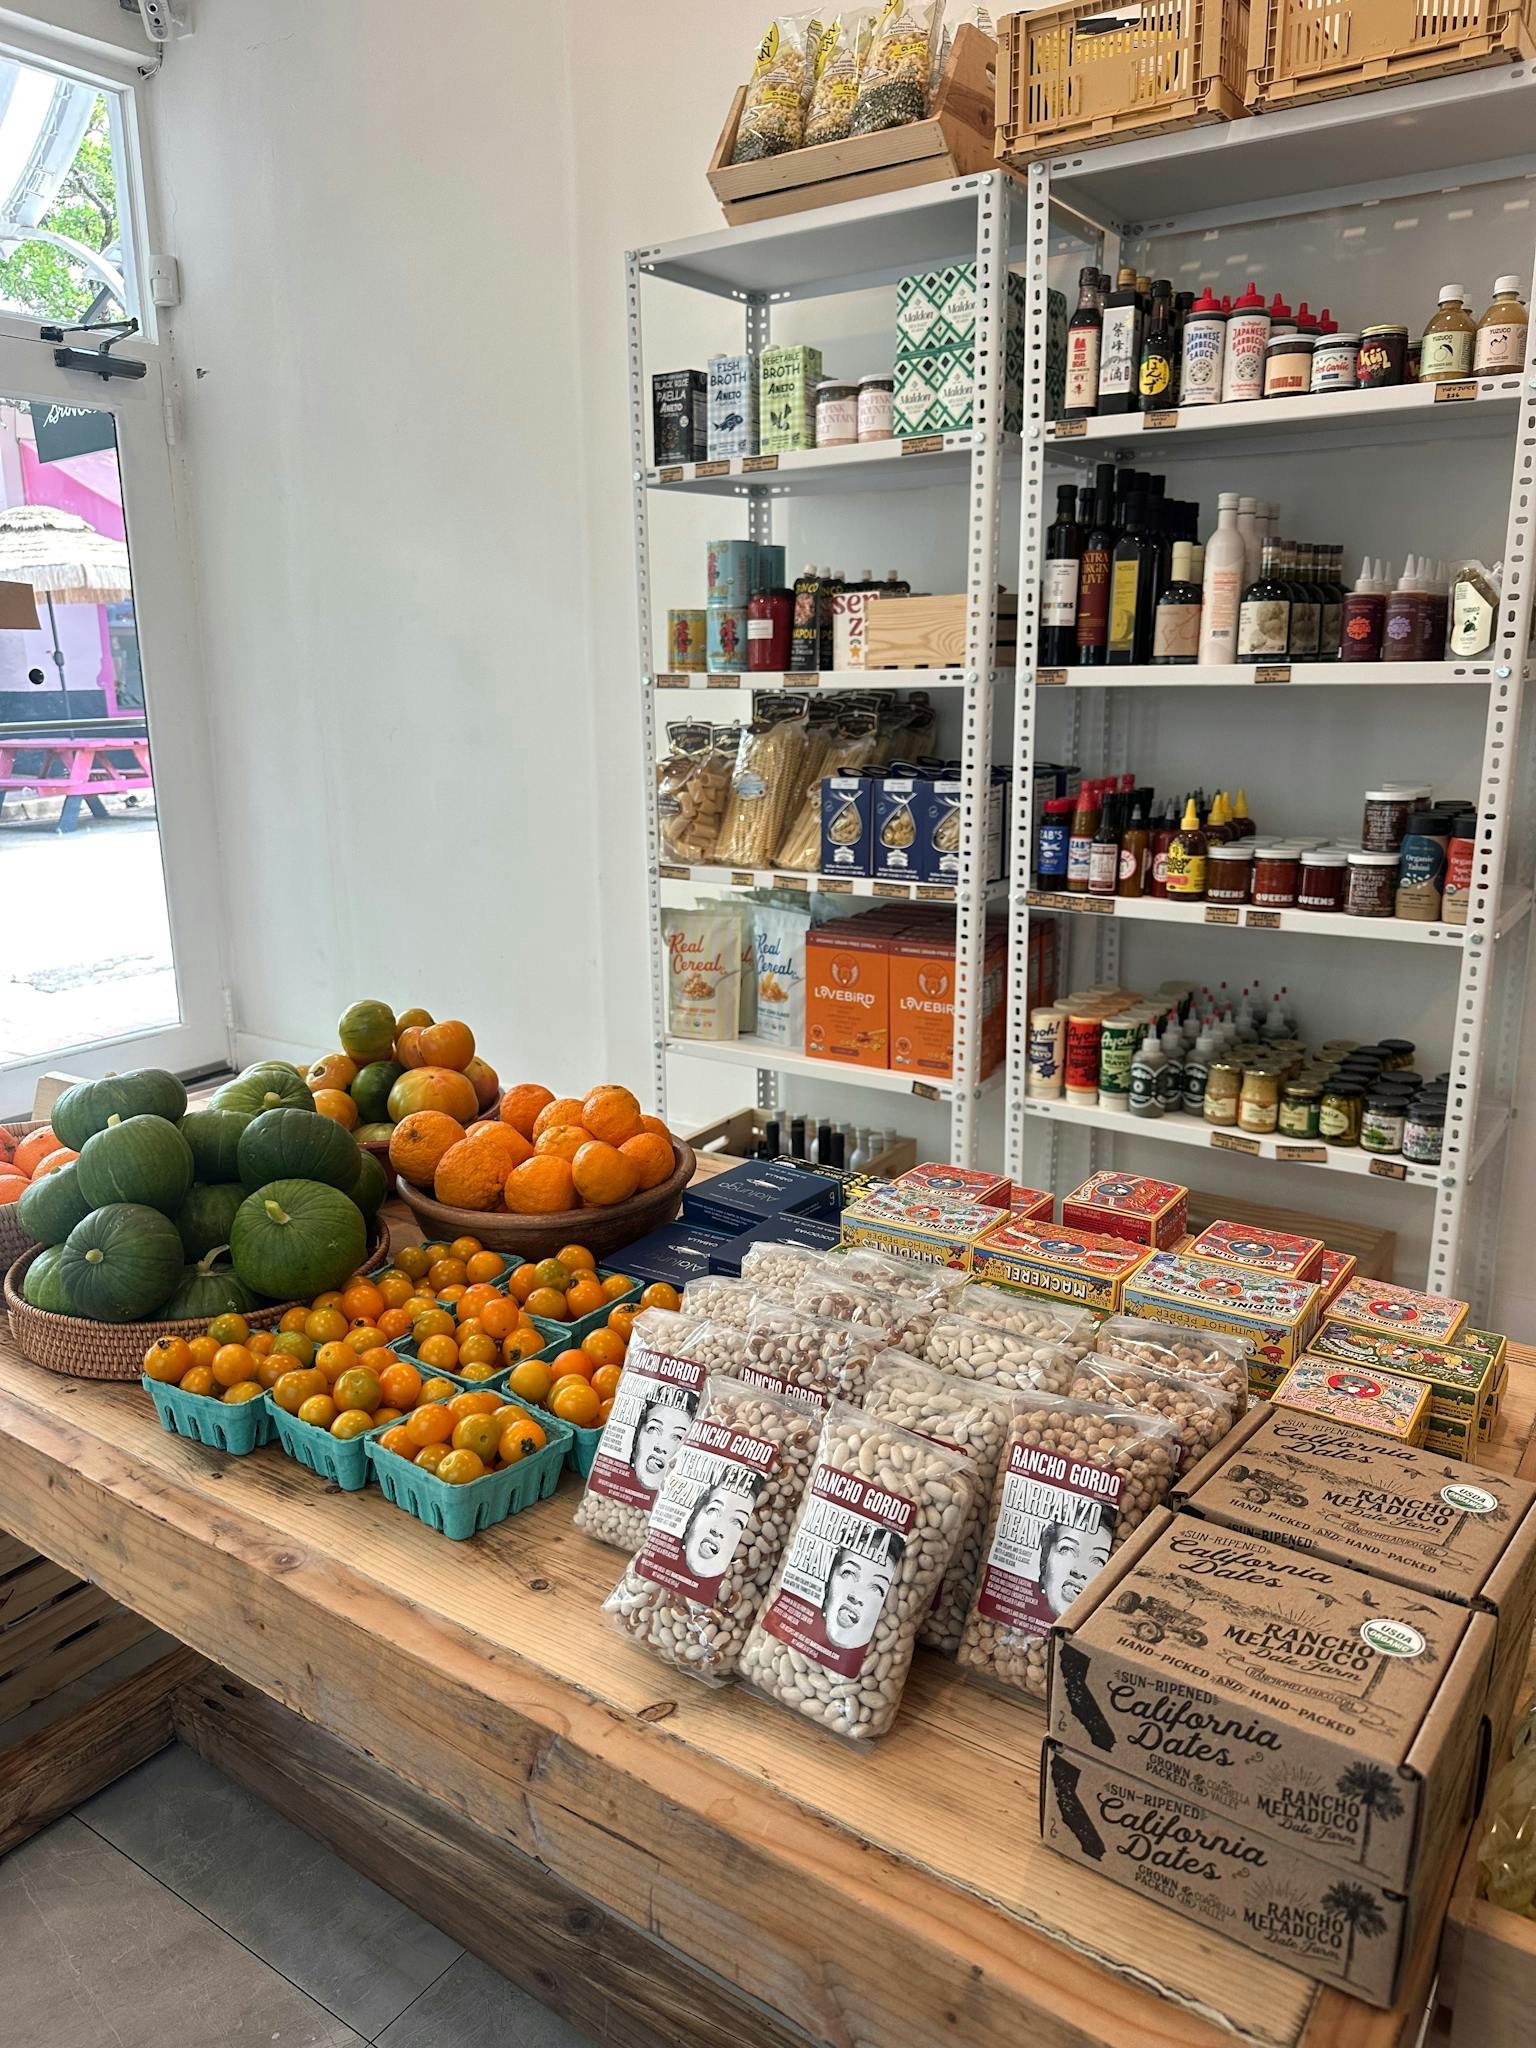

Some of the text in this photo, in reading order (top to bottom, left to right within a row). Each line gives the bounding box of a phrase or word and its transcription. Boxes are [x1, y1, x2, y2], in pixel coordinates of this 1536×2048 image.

[843, 84, 858, 93] CLAS
[903, 310, 934, 323] Maldon
[1233, 327, 1267, 341] JAPANESE
[761, 351, 801, 366] VEGETABLE
[1190, 350, 1213, 361] SAUCE
[1235, 346, 1261, 357] SAUCE
[710, 372, 747, 387] BROTH
[717, 361, 740, 374] FISH
[762, 364, 801, 379] BROTH
[656, 390, 687, 402] PAELLA
[900, 392, 931, 405] Maldon
[1207, 888, 1245, 899] QUEENS
[1255, 893, 1293, 903] QUEENS
[1298, 895, 1335, 906] QUEENS
[670, 932, 704, 955] Real
[757, 933, 782, 956] Real
[673, 953, 721, 975] Cereal
[757, 954, 793, 975] Cereal
[918, 1221, 975, 1232] SARDINES
[687, 1237, 719, 1248] CABALLA
[867, 1232, 943, 1254] WITH HOT PEPPER
[1025, 1246, 1080, 1262] MACKEREL
[1199, 1244, 1241, 1263] SALMON
[1004, 1264, 1087, 1300] MACKEREL
[1181, 1290, 1207, 1301] HOT
[1221, 1299, 1293, 1315] SARDINES
[1155, 1308, 1198, 1326] PEPPER
[1201, 1318, 1227, 1331] HOT
[1348, 1309, 1368, 1321] OLIVE
[1378, 1318, 1399, 1328] TUNA
[1402, 1322, 1443, 1334] ALBACORE
[1231, 1325, 1256, 1339] WITH
[631, 1350, 701, 1385] RANCHO GORDO
[1302, 1361, 1344, 1370] ALBACORE
[1349, 1368, 1372, 1377] TUNA
[1382, 1377, 1403, 1388] OLIVE
[610, 1392, 647, 1428] BEAN
[651, 1384, 690, 1412] BLANCA
[1274, 1423, 1418, 1461] California
[1284, 1420, 1360, 1439] SUN-RIPENED
[687, 1421, 774, 1466] RANCHO GORDO
[1281, 1441, 1374, 1464] Dates
[676, 1449, 757, 1499] YELLOW EYE
[1011, 1444, 1121, 1497] RANCHO GORDO
[661, 1475, 705, 1511] BEAN
[814, 1467, 912, 1526] RANCHO GORDO
[1005, 1476, 1102, 1535] GARBANZO
[1357, 1489, 1455, 1517] RANCHO
[1458, 1487, 1487, 1504] USDA
[1322, 1490, 1449, 1526] MELADUCO
[1346, 1508, 1441, 1534] Date Farm
[800, 1498, 893, 1568] MARCELLA
[998, 1508, 1046, 1550] BEAN
[1184, 1529, 1267, 1554] SUN-RIPENED
[1230, 1498, 1437, 1574] HAND-PICKED AND HAND-PACKED
[788, 1530, 839, 1583] BEAN
[1170, 1535, 1334, 1585] California
[1178, 1558, 1284, 1589] Dates
[1263, 1621, 1376, 1659] RANCHO
[1368, 1626, 1413, 1656] ORGANIC
[1379, 1622, 1414, 1645] USDA
[1224, 1624, 1370, 1673] MELADUCO
[1249, 1647, 1364, 1682] Date Farm
[1116, 1636, 1357, 1738] HAND-PICKED AND HAND-PACKED
[1120, 1671, 1213, 1705] SUN-RIPENED
[1106, 1680, 1282, 1752] California
[1127, 1722, 1235, 1767] Dates
[1146, 1762, 1188, 1788] PACKED
[1149, 1753, 1191, 1779] GROWN
[1110, 1784, 1200, 1820] SUN-RIPENED
[1257, 1795, 1359, 1834] MELADUCO
[1281, 1787, 1361, 1818] RANCHO
[1096, 1791, 1268, 1867] California
[1278, 1817, 1357, 1846] Date Farm
[1116, 1833, 1221, 1881] Dates
[1134, 1872, 1176, 1899] PACKED
[1138, 1864, 1179, 1890] GROWN
[1243, 1908, 1343, 1949] MELADUCO
[1267, 1902, 1345, 1935] RANCHO
[1264, 1932, 1299, 1948] Date
